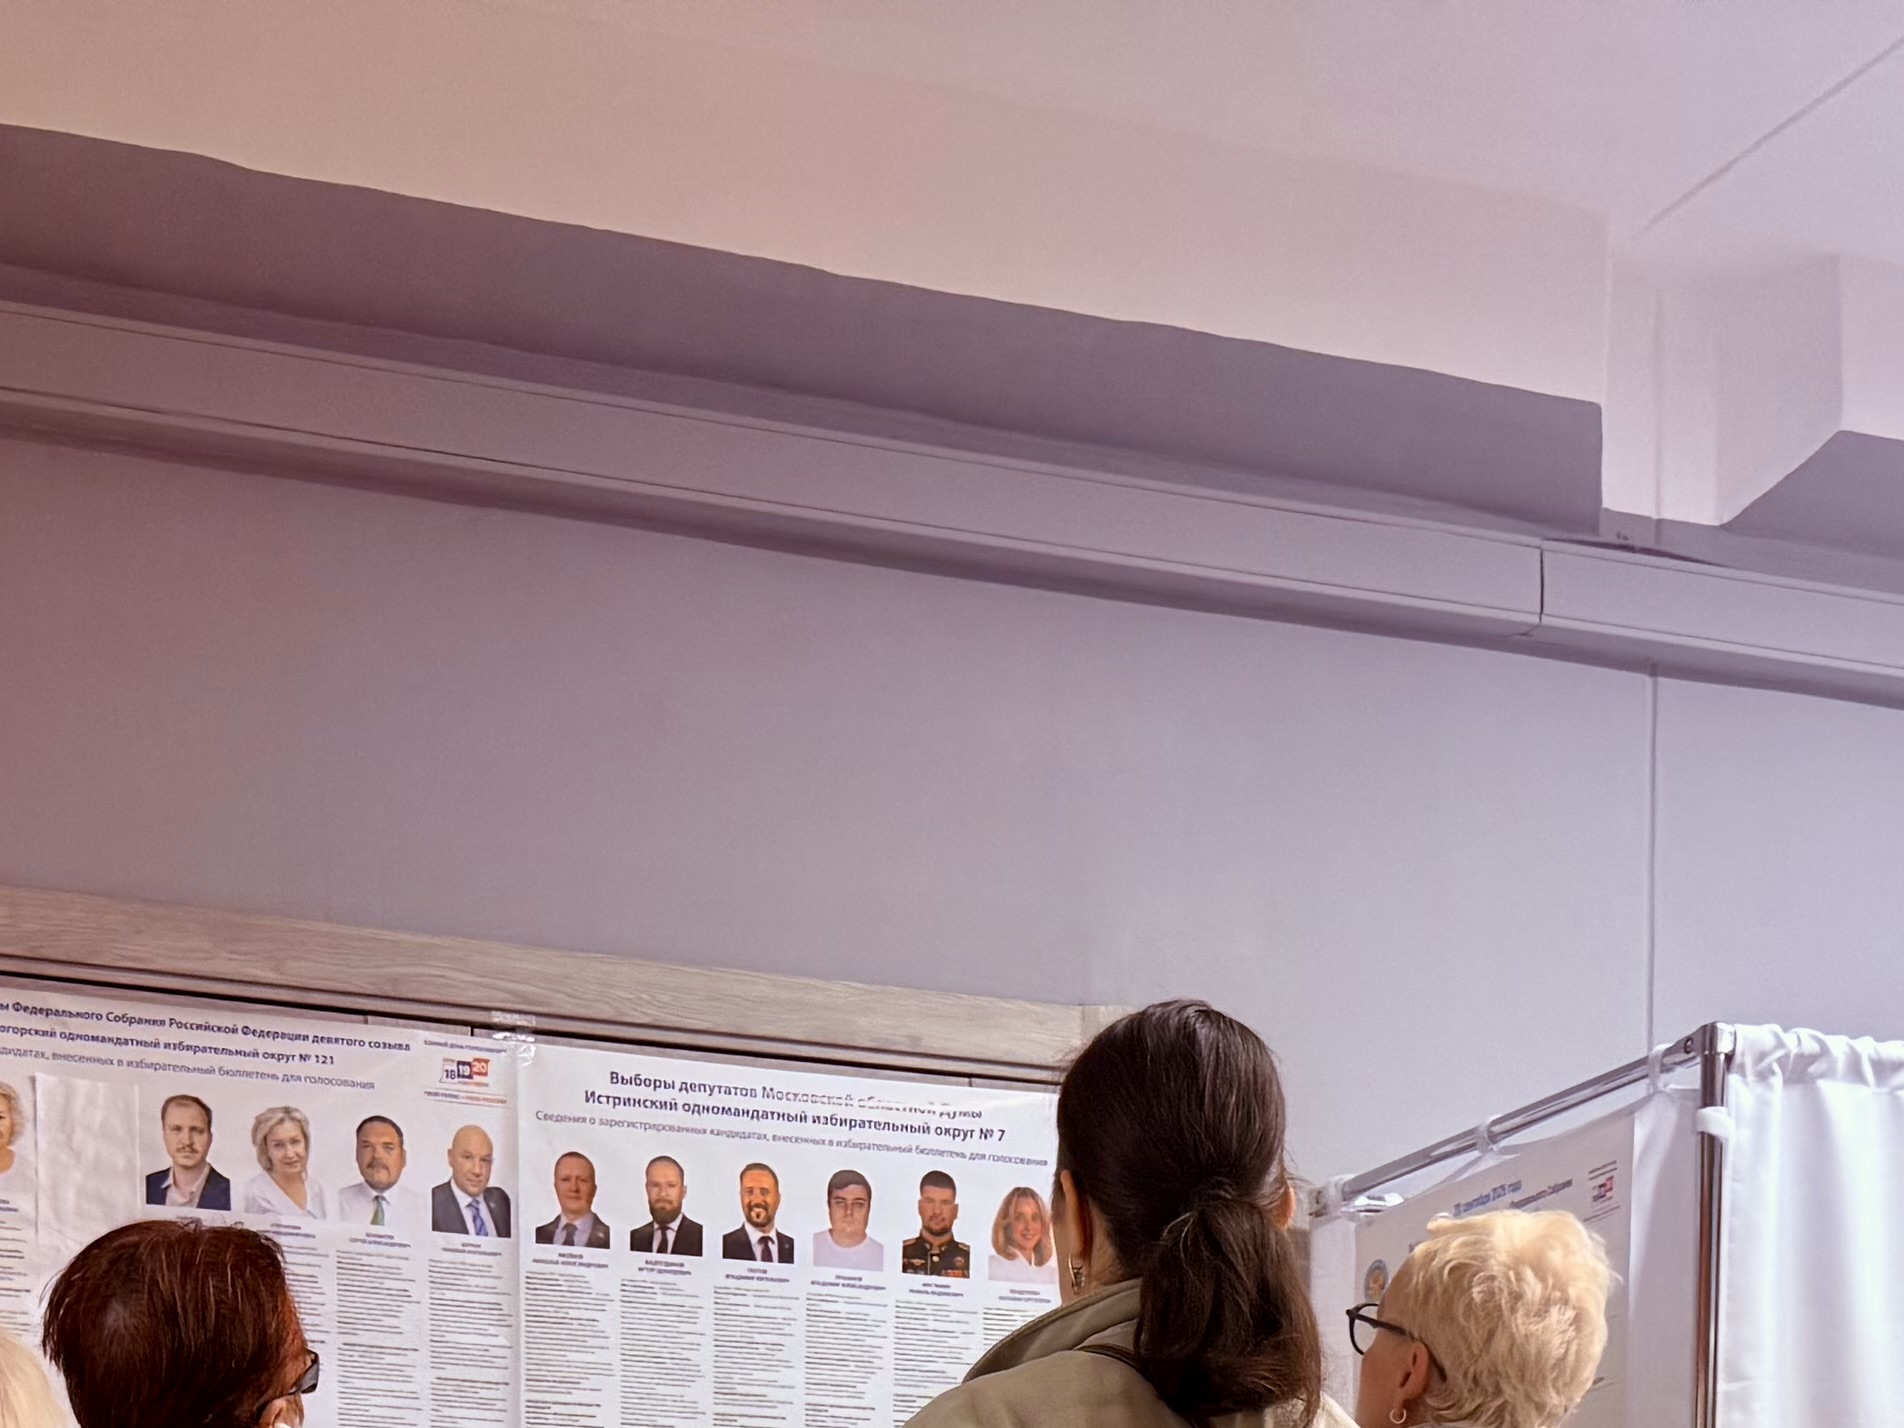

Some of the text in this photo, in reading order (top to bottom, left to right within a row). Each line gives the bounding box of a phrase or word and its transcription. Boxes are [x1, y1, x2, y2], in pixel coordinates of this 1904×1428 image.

[12, 1002, 103, 1021] Федерального
[106, 1012, 166, 1028] Собрания
[169, 1017, 239, 1035] Российской
[241, 1024, 310, 1043] Федерации
[312, 1034, 366, 1049] девятого
[59, 1030, 161, 1049] одномандатный
[163, 1040, 259, 1059] избирательный
[262, 1051, 296, 1063] округ
[298, 1052, 311, 1063] №
[314, 1054, 335, 1065] 121
[444, 1068, 456, 1080] 18
[472, 1062, 488, 1073] 20
[610, 1071, 676, 1091] Выборы
[678, 1080, 758, 1099] депутатов
[584, 1089, 1006, 1142] Истринский одномандатный избирательный округ № 7
